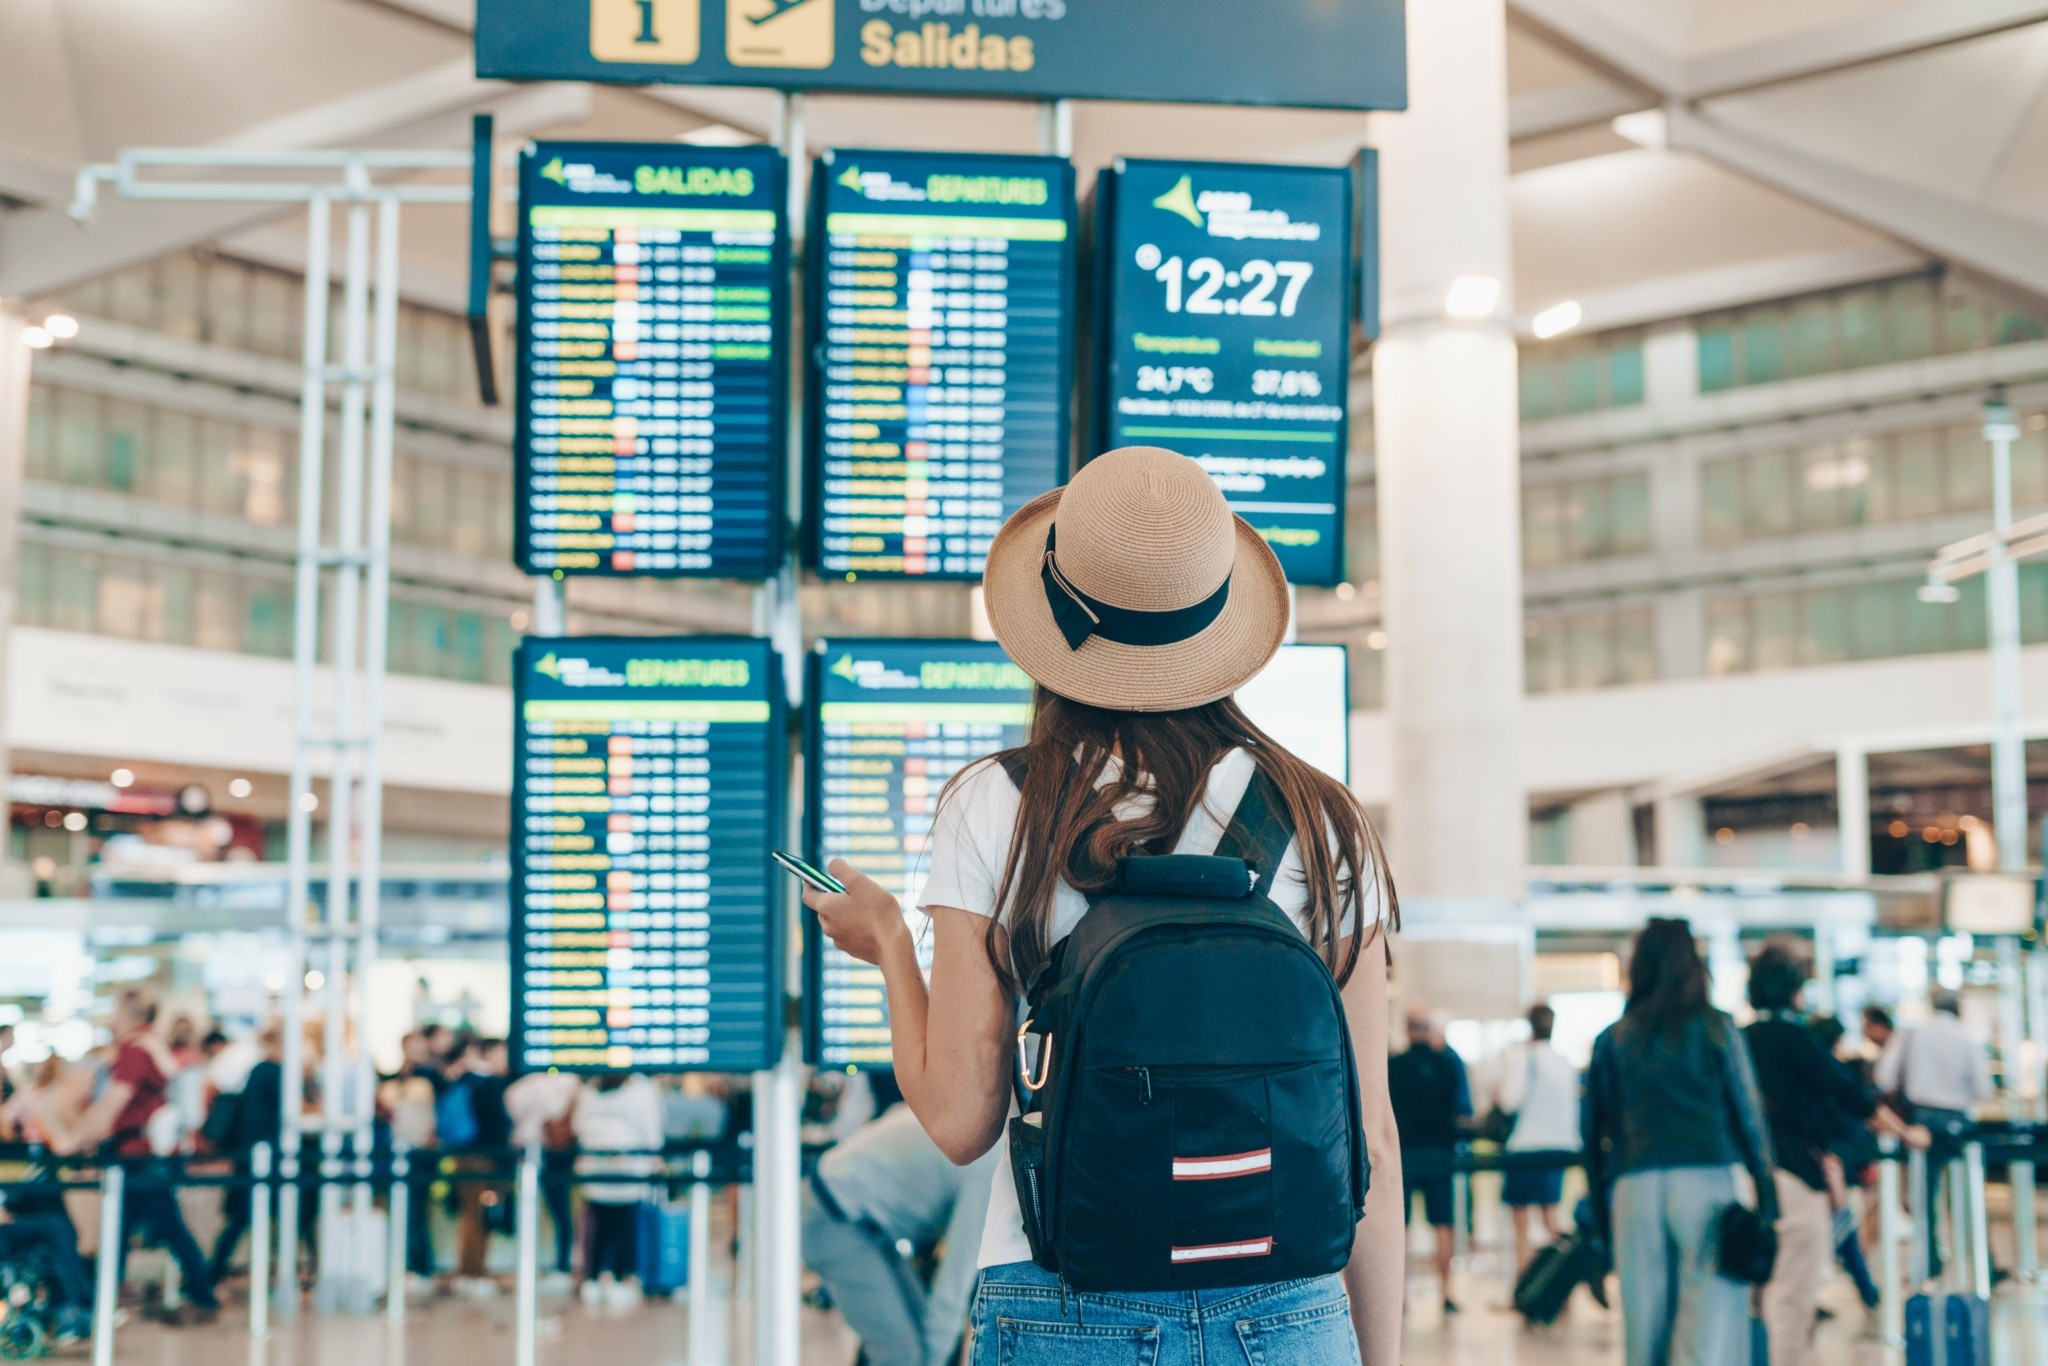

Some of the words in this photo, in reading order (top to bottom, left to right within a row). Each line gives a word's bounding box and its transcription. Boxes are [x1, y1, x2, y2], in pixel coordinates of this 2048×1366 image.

[860, 19, 1035, 72] Salidas
[634, 165, 754, 196] SALIDAS
[927, 174, 1048, 205] DEPARTURES
[1155, 256, 1313, 317] 12:27
[626, 659, 750, 687] DEPARTURES
[920, 661, 1036, 689] DEPARTURE
